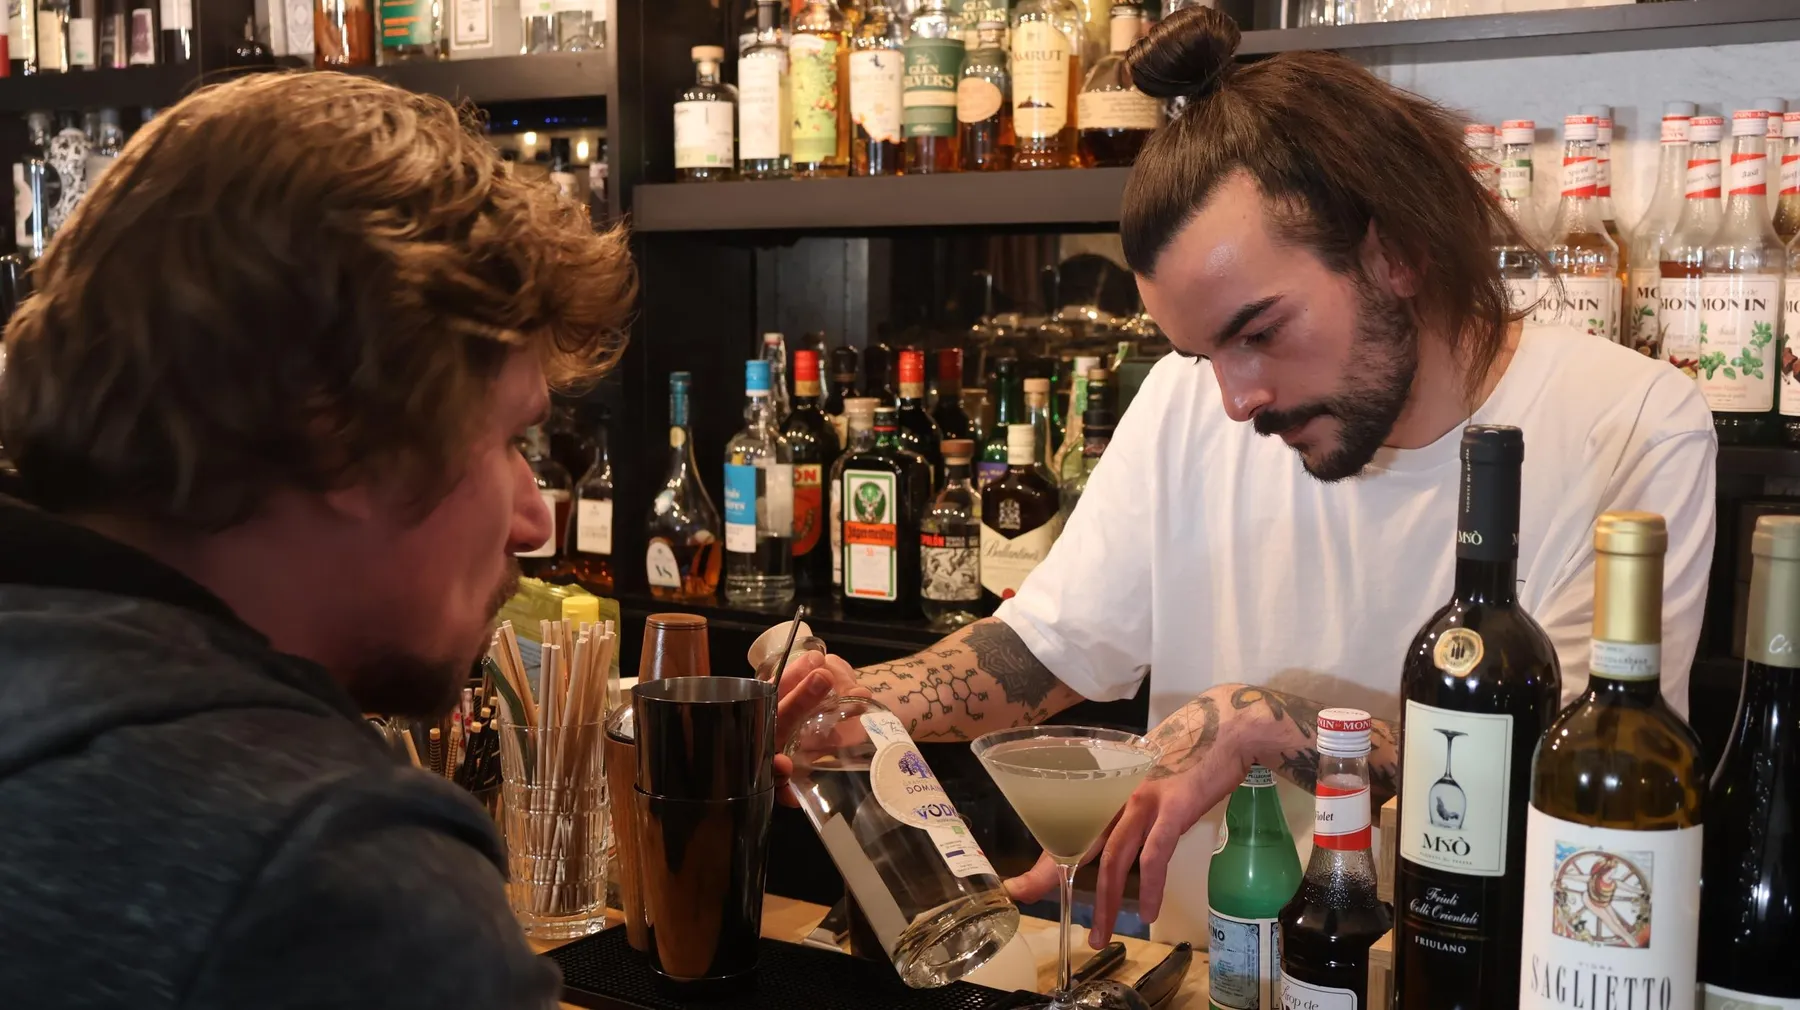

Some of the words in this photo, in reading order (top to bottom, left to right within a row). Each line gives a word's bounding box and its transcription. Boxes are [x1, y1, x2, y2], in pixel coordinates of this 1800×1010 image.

[908, 64, 939, 74] GLEN
[1703, 298, 1766, 311] MONIN
[1422, 832, 1470, 856] MYÒ
[1426, 887, 1459, 905] Friuli
[1431, 905, 1479, 925] Orientali
[1415, 935, 1466, 954] FRIULANO
[1531, 954, 1672, 1010] SAGLIETTO
[1304, 999, 1319, 1010] de
